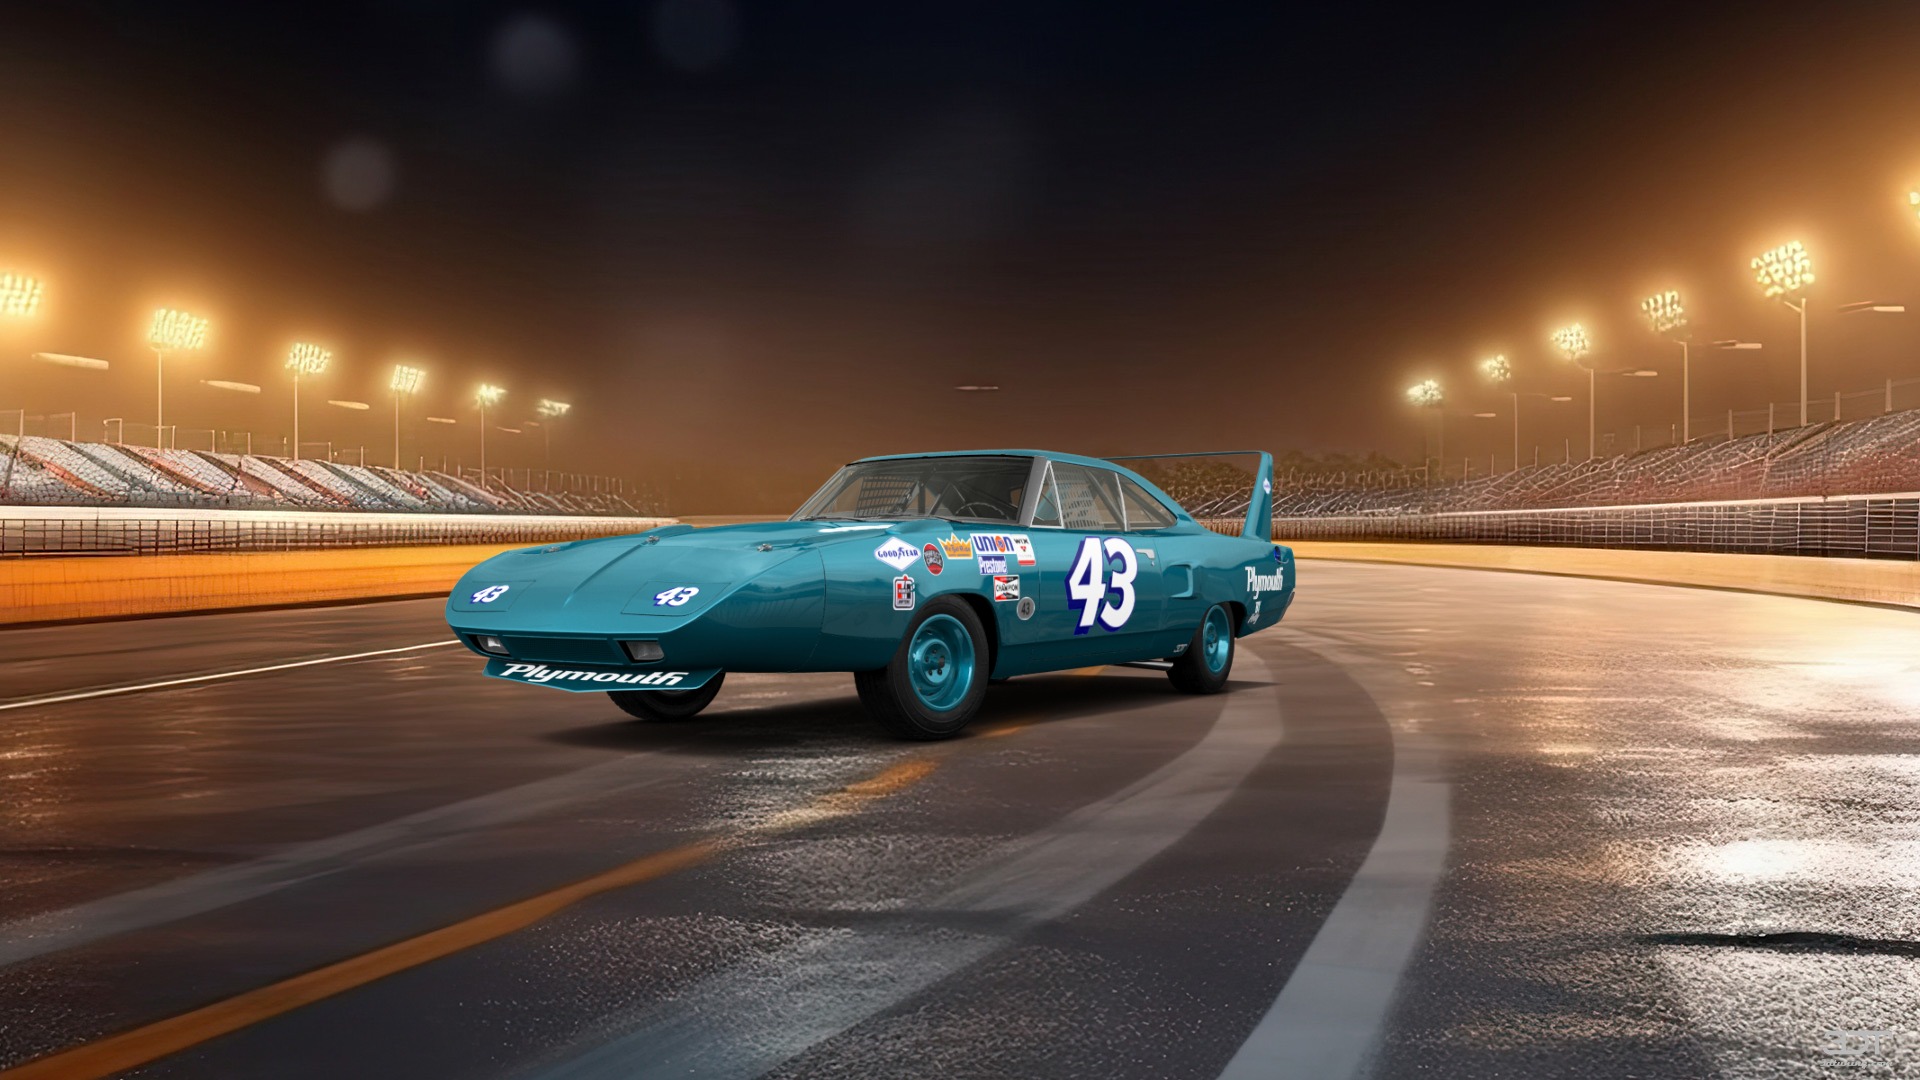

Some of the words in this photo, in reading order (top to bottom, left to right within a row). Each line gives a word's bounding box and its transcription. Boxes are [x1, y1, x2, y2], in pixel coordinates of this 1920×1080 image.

[877, 547, 919, 559] GOODYEAR
[973, 535, 1014, 553] UNION
[979, 556, 1006, 573] Prestone
[996, 583, 1019, 592] CHAMPION
[1064, 535, 1138, 636] 43
[1244, 566, 1284, 600] Plymouth
[470, 584, 510, 605] 43
[653, 586, 700, 607] 43
[1021, 602, 1030, 615] 43
[499, 663, 690, 687] Plymouth
